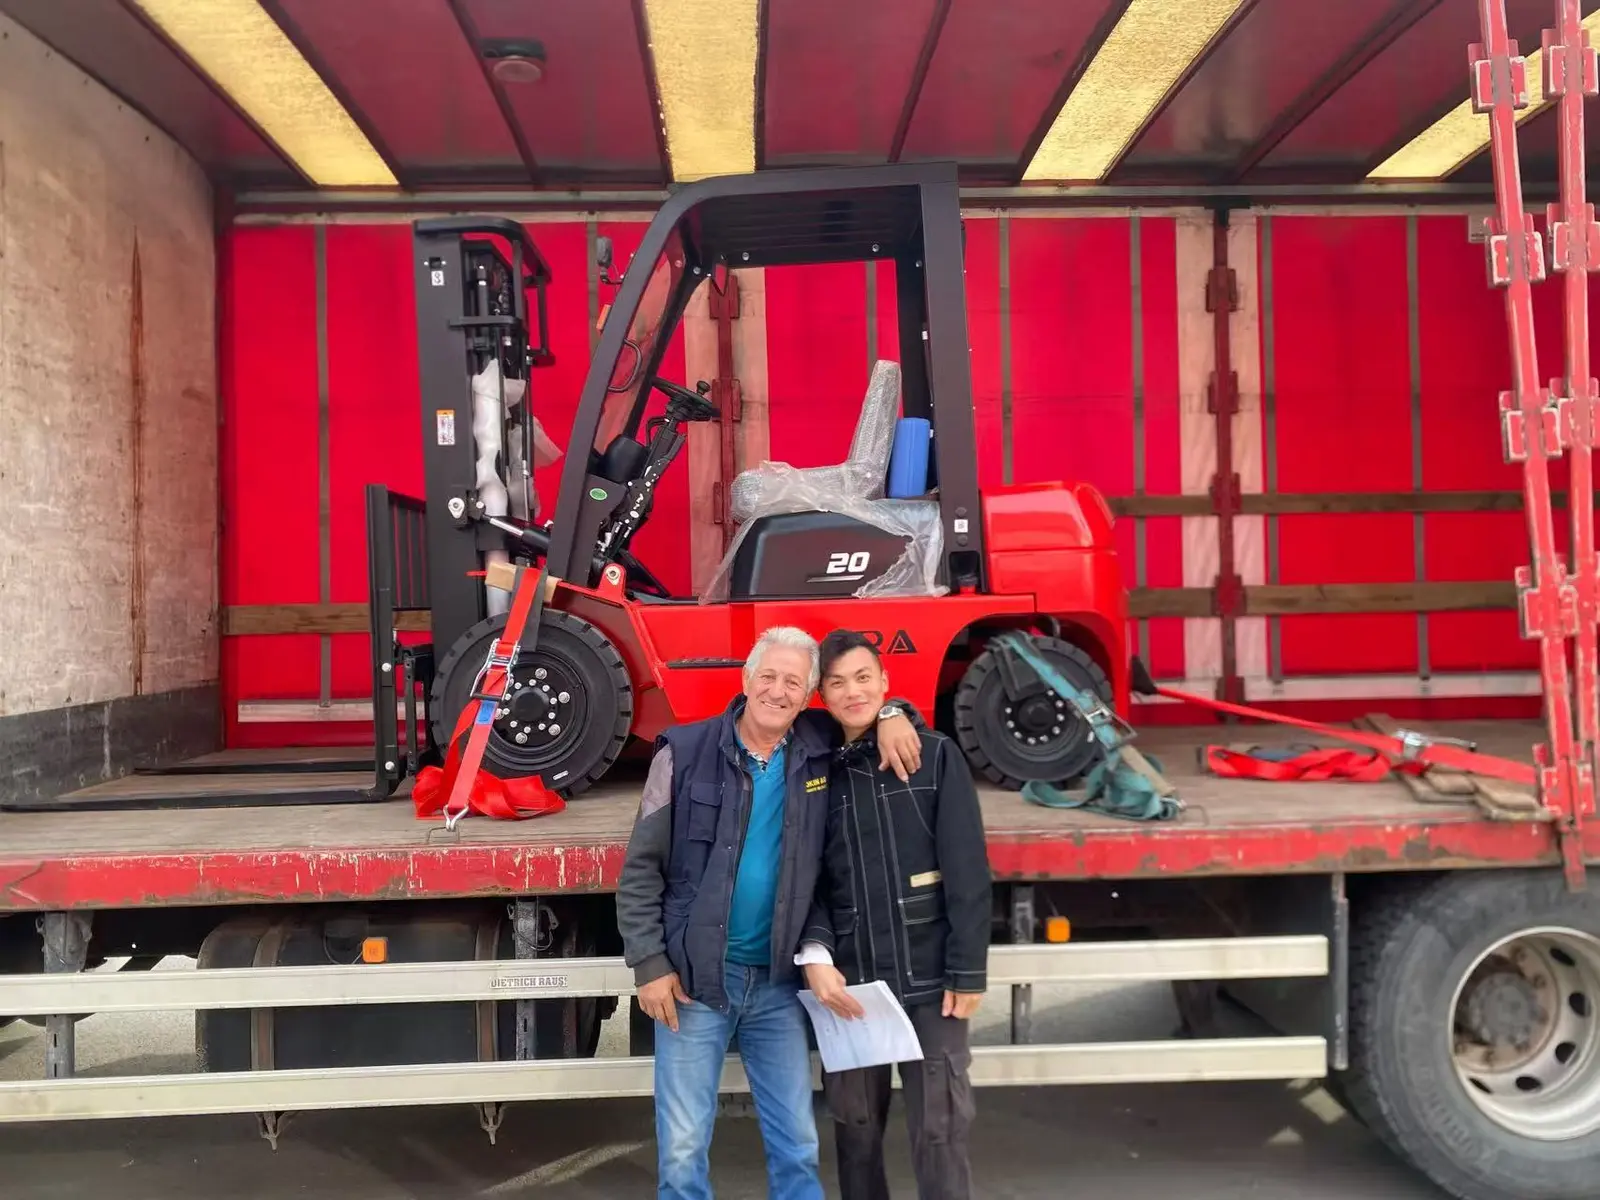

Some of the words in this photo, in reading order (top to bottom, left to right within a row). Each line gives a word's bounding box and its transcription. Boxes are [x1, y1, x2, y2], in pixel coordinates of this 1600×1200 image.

[826, 551, 870, 574] 20
[853, 629, 918, 655] RA
[491, 977, 536, 988] DIETRICH
